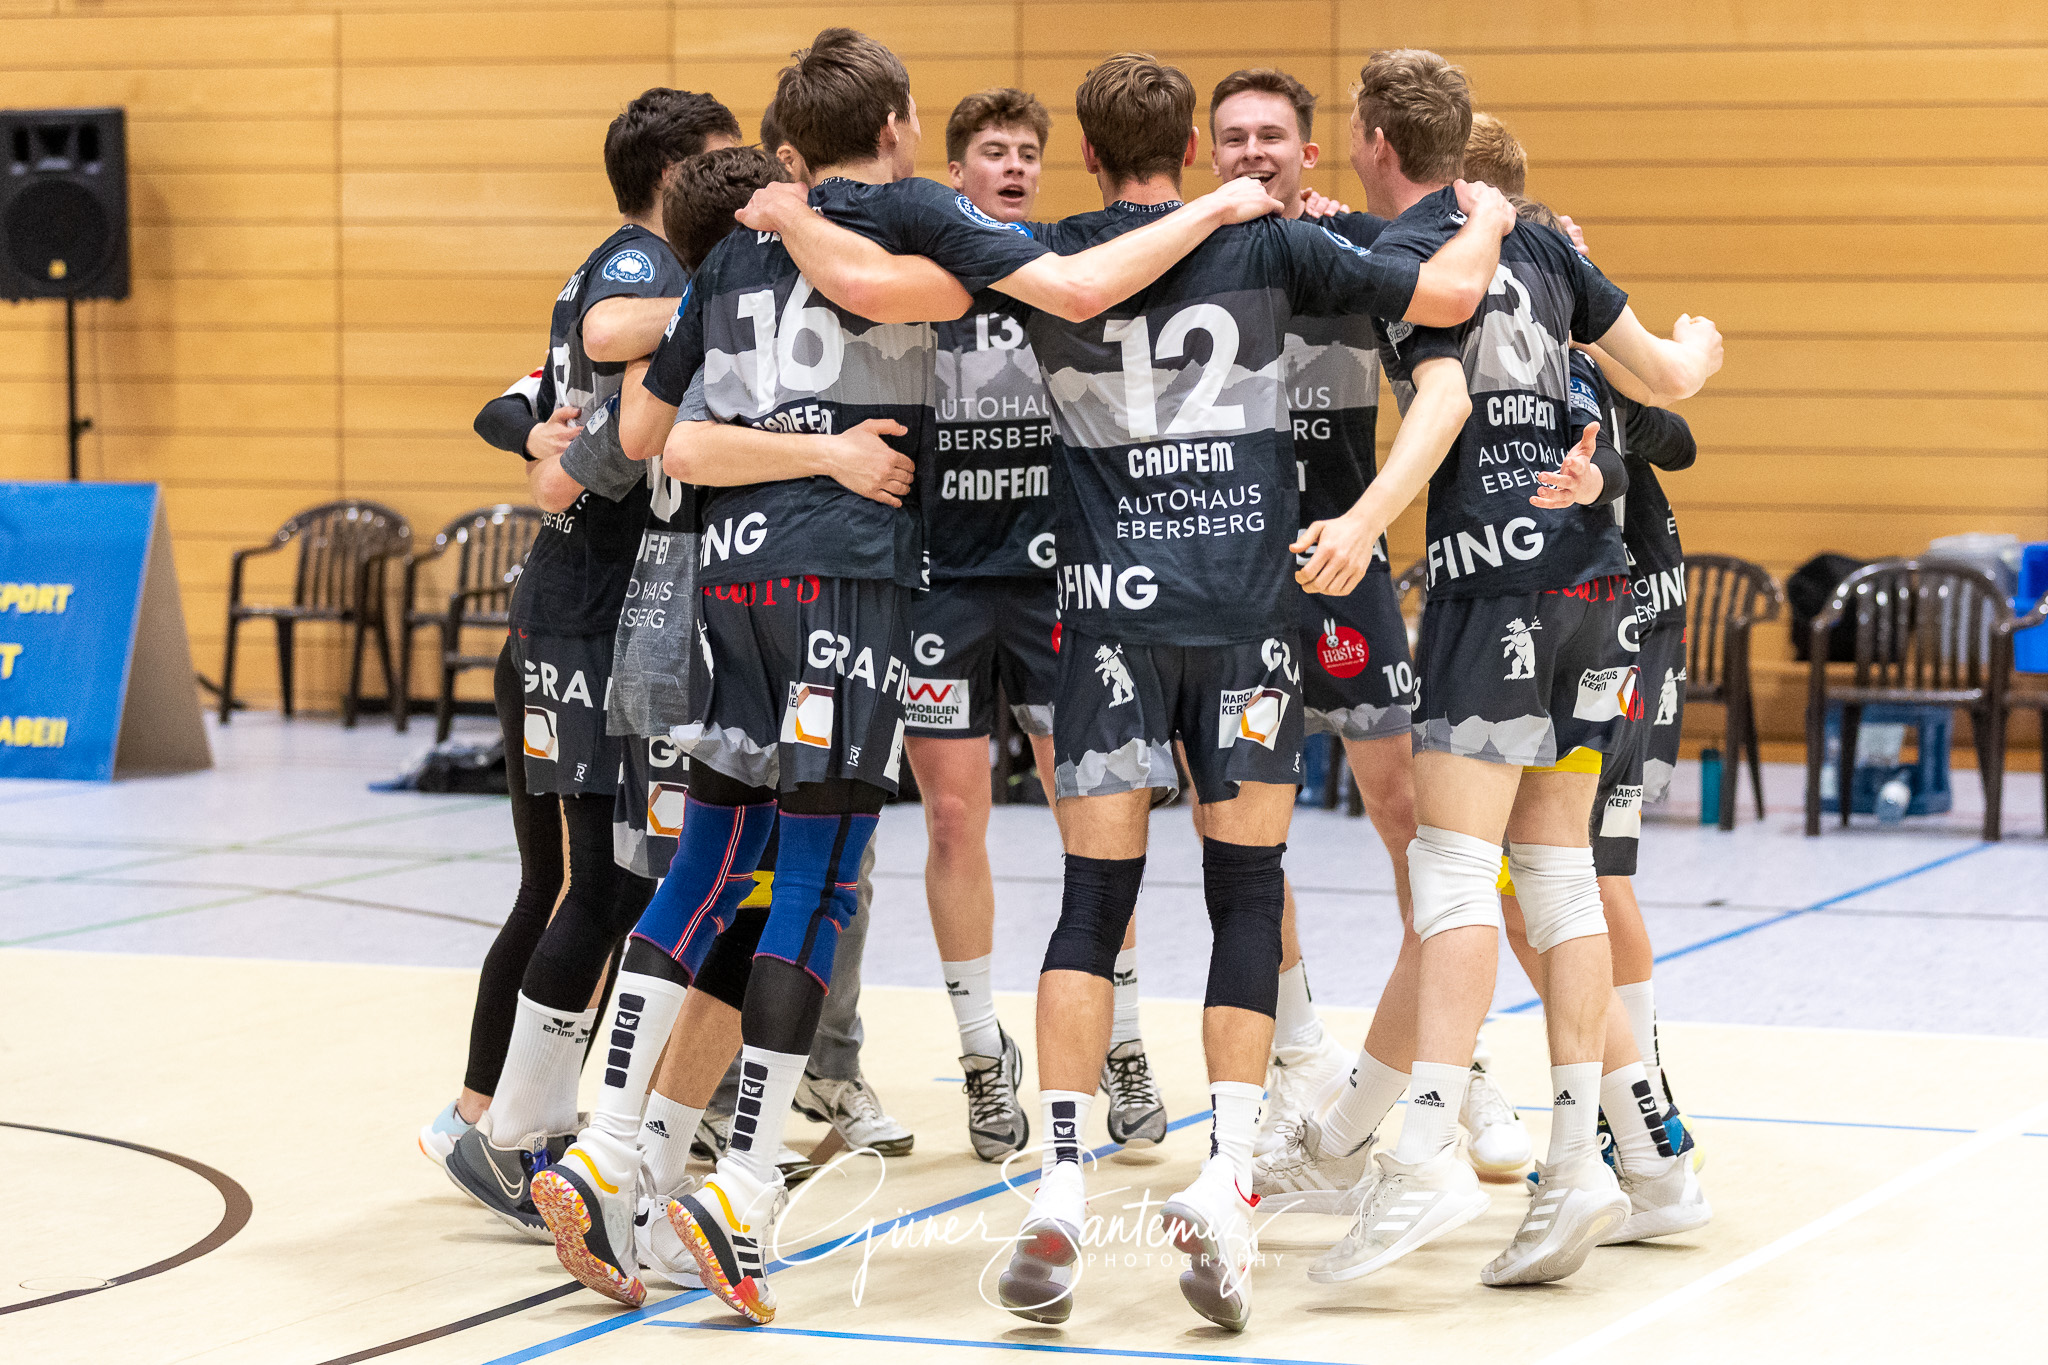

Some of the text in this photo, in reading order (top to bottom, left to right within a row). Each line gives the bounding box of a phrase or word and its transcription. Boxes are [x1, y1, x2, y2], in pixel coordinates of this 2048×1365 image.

[976, 312, 1024, 351] 13
[1487, 263, 1545, 385] 3
[737, 272, 845, 413] 16
[1103, 303, 1247, 438] 12
[935, 425, 1052, 451] BERSBER
[1128, 442, 1236, 479] CADFEM
[941, 465, 1050, 501] CADFEM
[1118, 484, 1262, 515] AUTOHAUS
[1117, 512, 1265, 540] EBERSBERG
[1426, 517, 1545, 592] FING
[0, 583, 74, 613] PORT
[1382, 661, 1413, 698] 10
[1580, 678, 1607, 692] KERTI
[1585, 670, 1618, 682] MARCUS
[543, 1023, 575, 1037] erima
[1414, 1098, 1445, 1108] adidas
[646, 1122, 670, 1139] adidas
